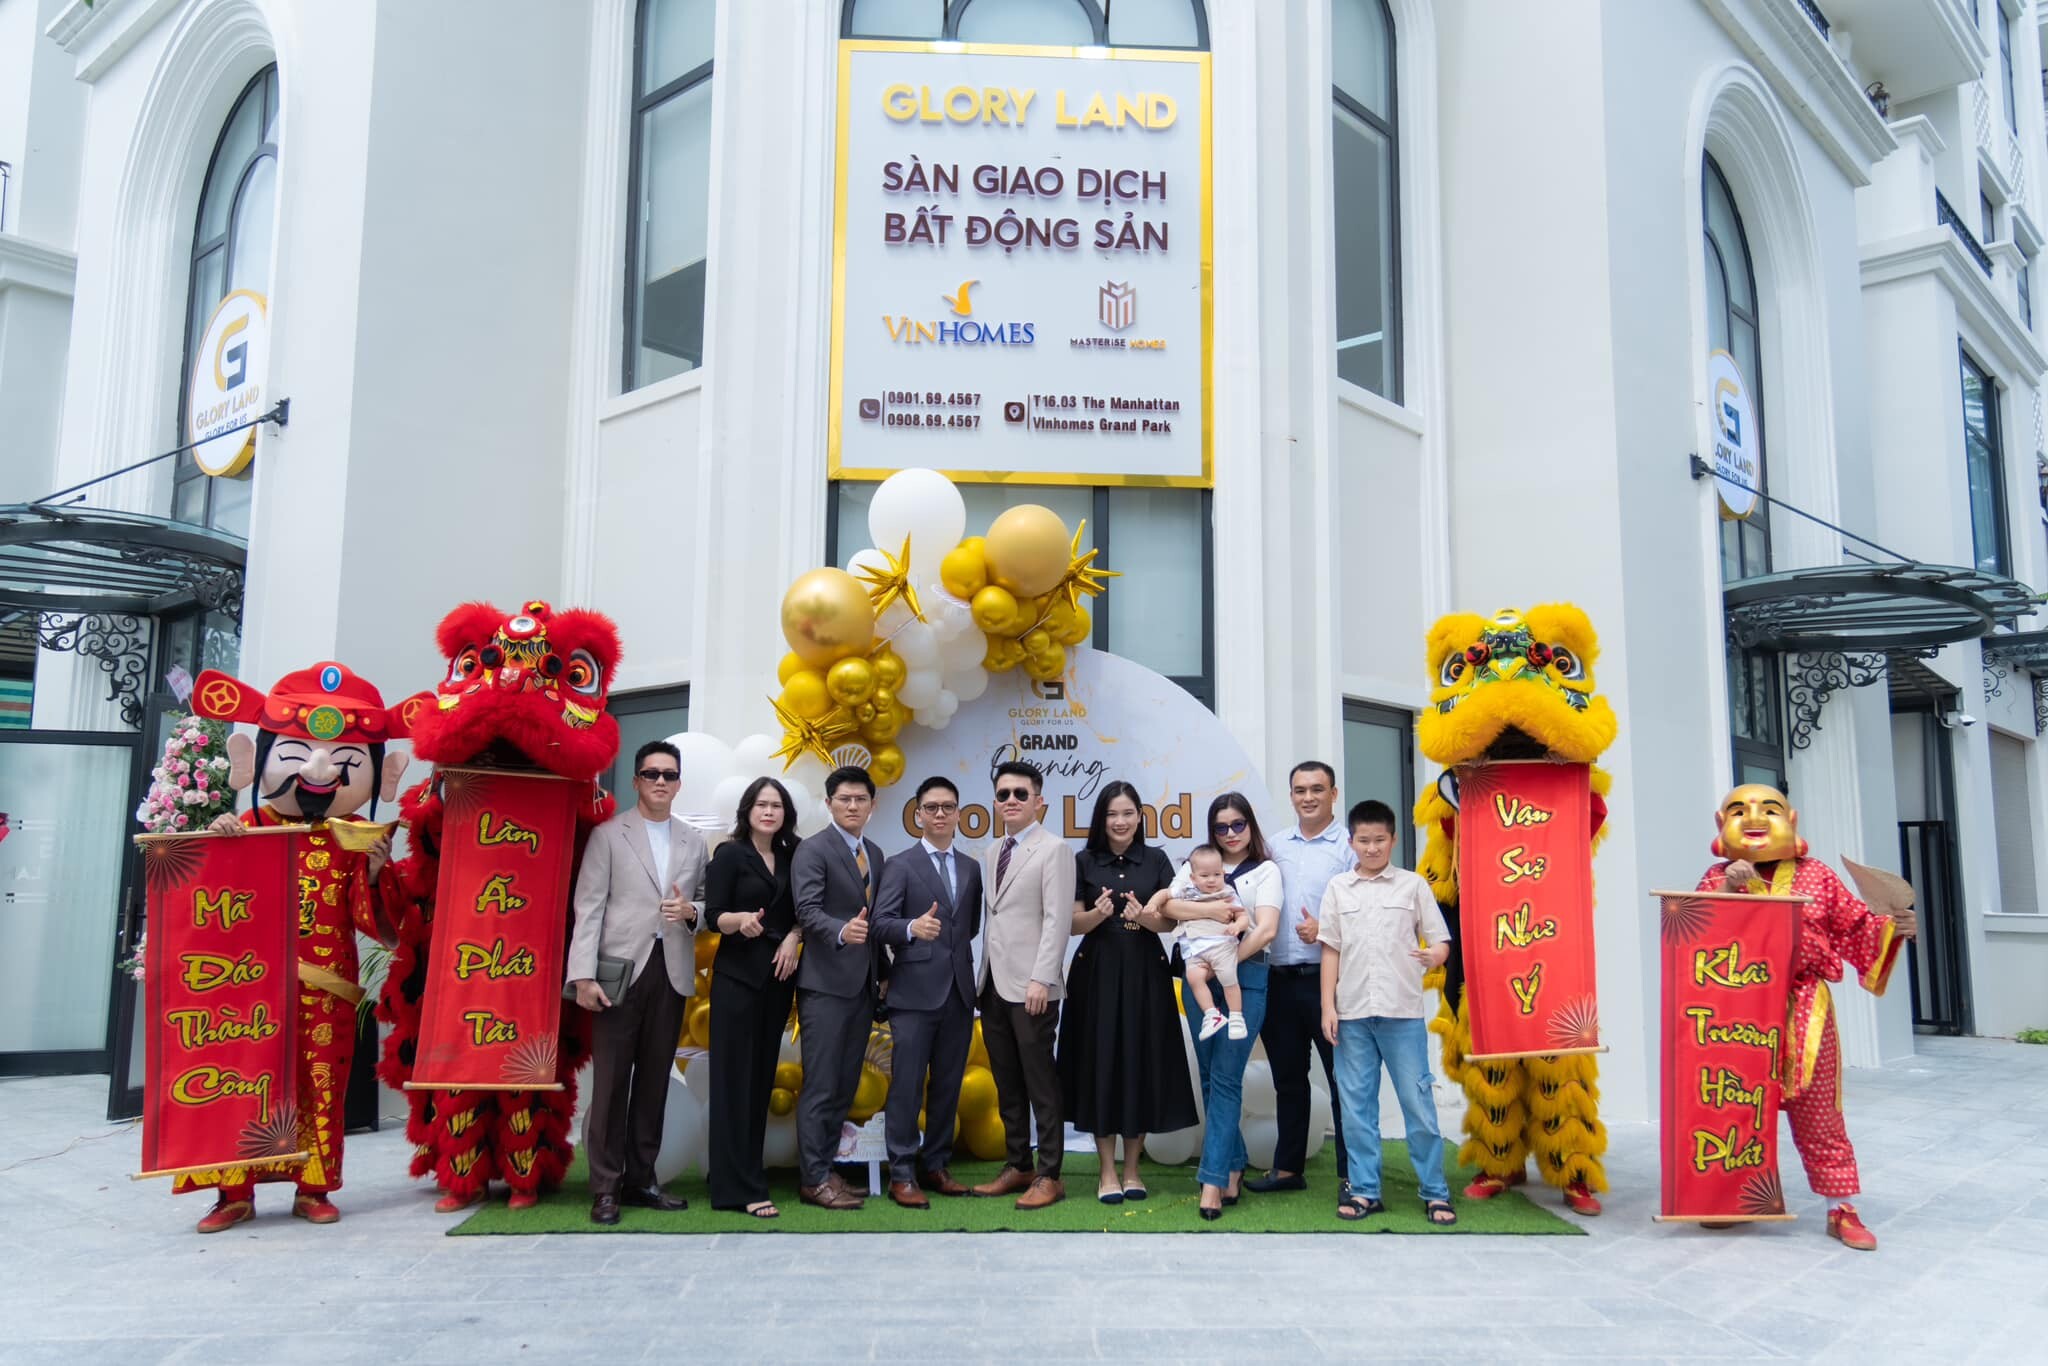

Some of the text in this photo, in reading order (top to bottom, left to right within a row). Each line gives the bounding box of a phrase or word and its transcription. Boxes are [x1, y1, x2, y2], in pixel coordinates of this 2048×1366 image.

[881, 83, 1178, 129] GLORY LAND
[882, 154, 1167, 206] SÀN GIAO DỊCH
[884, 205, 1169, 253] BẤT ĐỘNG SẢN
[1070, 337, 1167, 350] MASTERISE HOMES
[196, 384, 260, 430] GLORY LAND
[888, 391, 981, 406] 0901.69.4567
[1033, 394, 1180, 411] T16.03 The Manhattan
[888, 413, 981, 428] 0908.69.4567
[1099, 418, 1137, 432] Grand
[1142, 420, 1172, 433] Park
[1008, 708, 1087, 718] GLORY LAND
[1020, 734, 1079, 750] GRAND
[1062, 792, 1193, 839] Lnd
[1495, 794, 1551, 827] Vạn
[478, 812, 538, 853] Làm
[1502, 847, 1546, 884] Sự
[194, 889, 253, 929] Mã
[1496, 903, 1556, 950] Như
[181, 954, 265, 991] Đáo
[457, 940, 534, 980] Phát
[1694, 942, 1770, 988] Khai
[1511, 963, 1541, 1014] Ý
[168, 1004, 278, 1049] Thành
[464, 1012, 518, 1045] Tài
[1686, 1006, 1780, 1081] Trường
[172, 1066, 272, 1125] Công
[1700, 1067, 1765, 1131] Hồng
[1693, 1126, 1764, 1172] Phát
